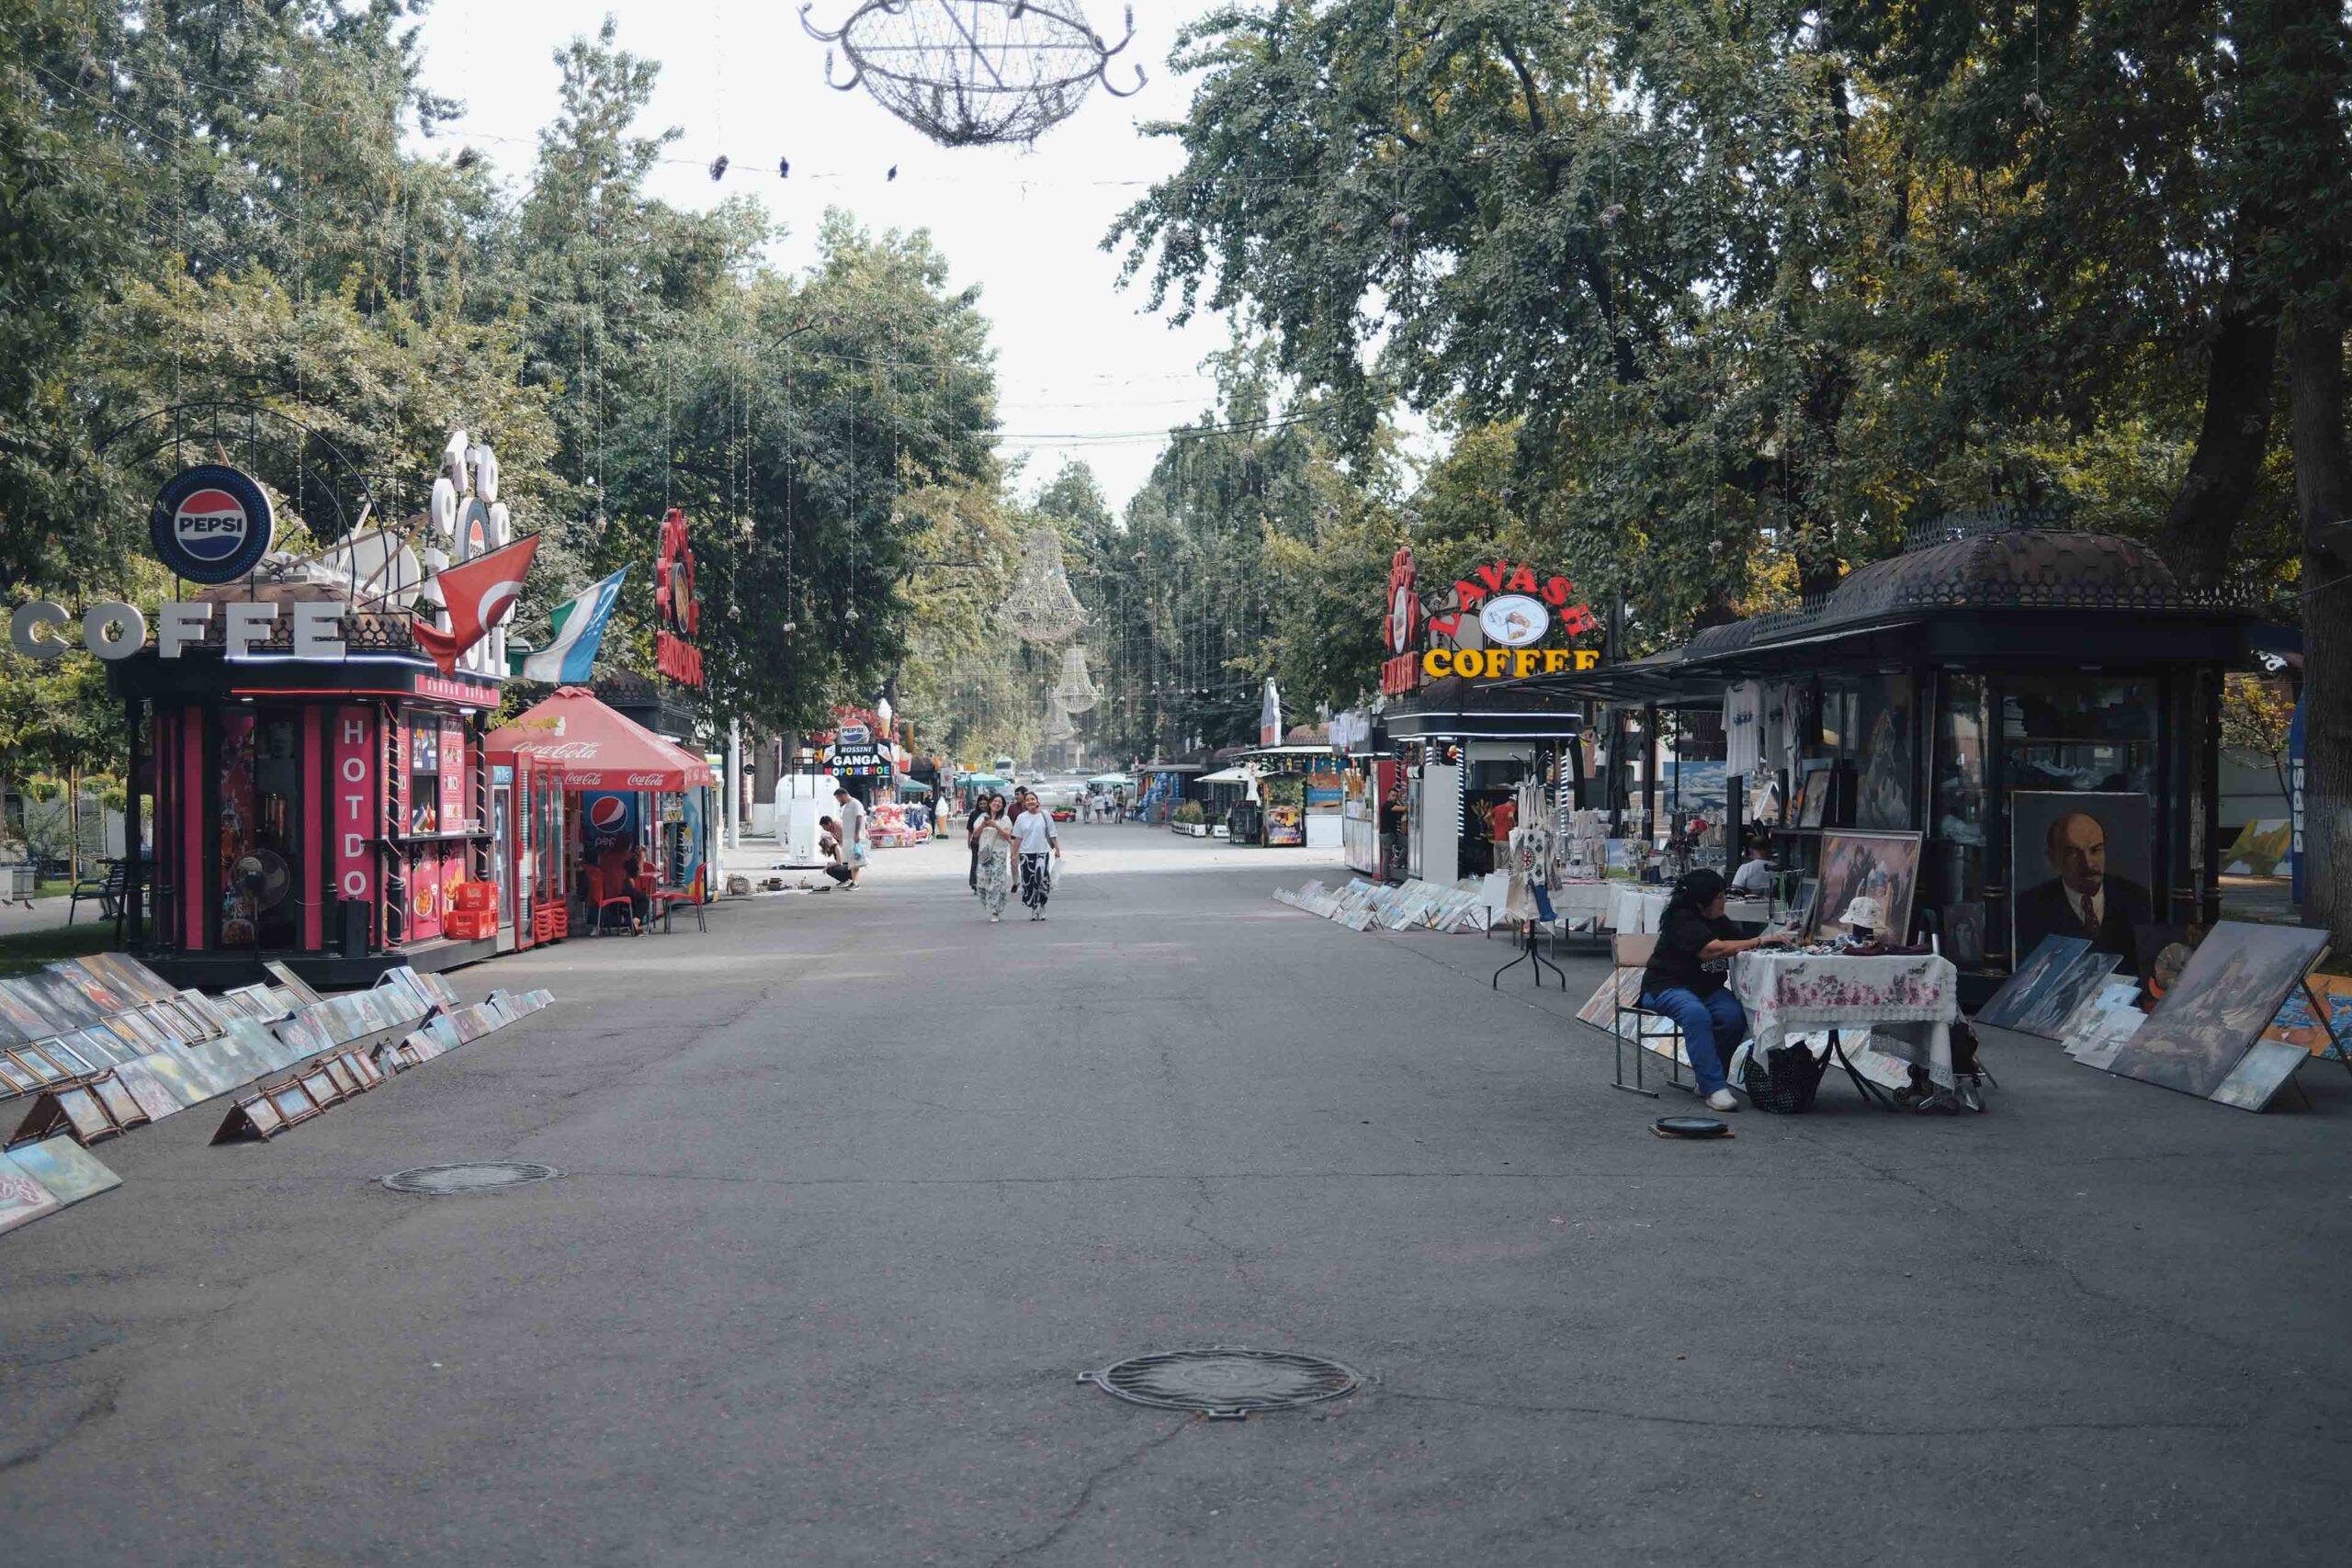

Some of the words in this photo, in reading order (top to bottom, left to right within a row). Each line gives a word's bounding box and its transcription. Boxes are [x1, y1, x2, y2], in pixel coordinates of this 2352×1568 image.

[179, 517, 243, 532] PEPSI
[10, 602, 345, 660] COFFE
[840, 746, 873, 754] ROSSINI
[832, 755, 881, 766] GANGA
[824, 766, 890, 776] МОРОЖЕНОЕ
[2292, 758, 2305, 853] PEPSI
